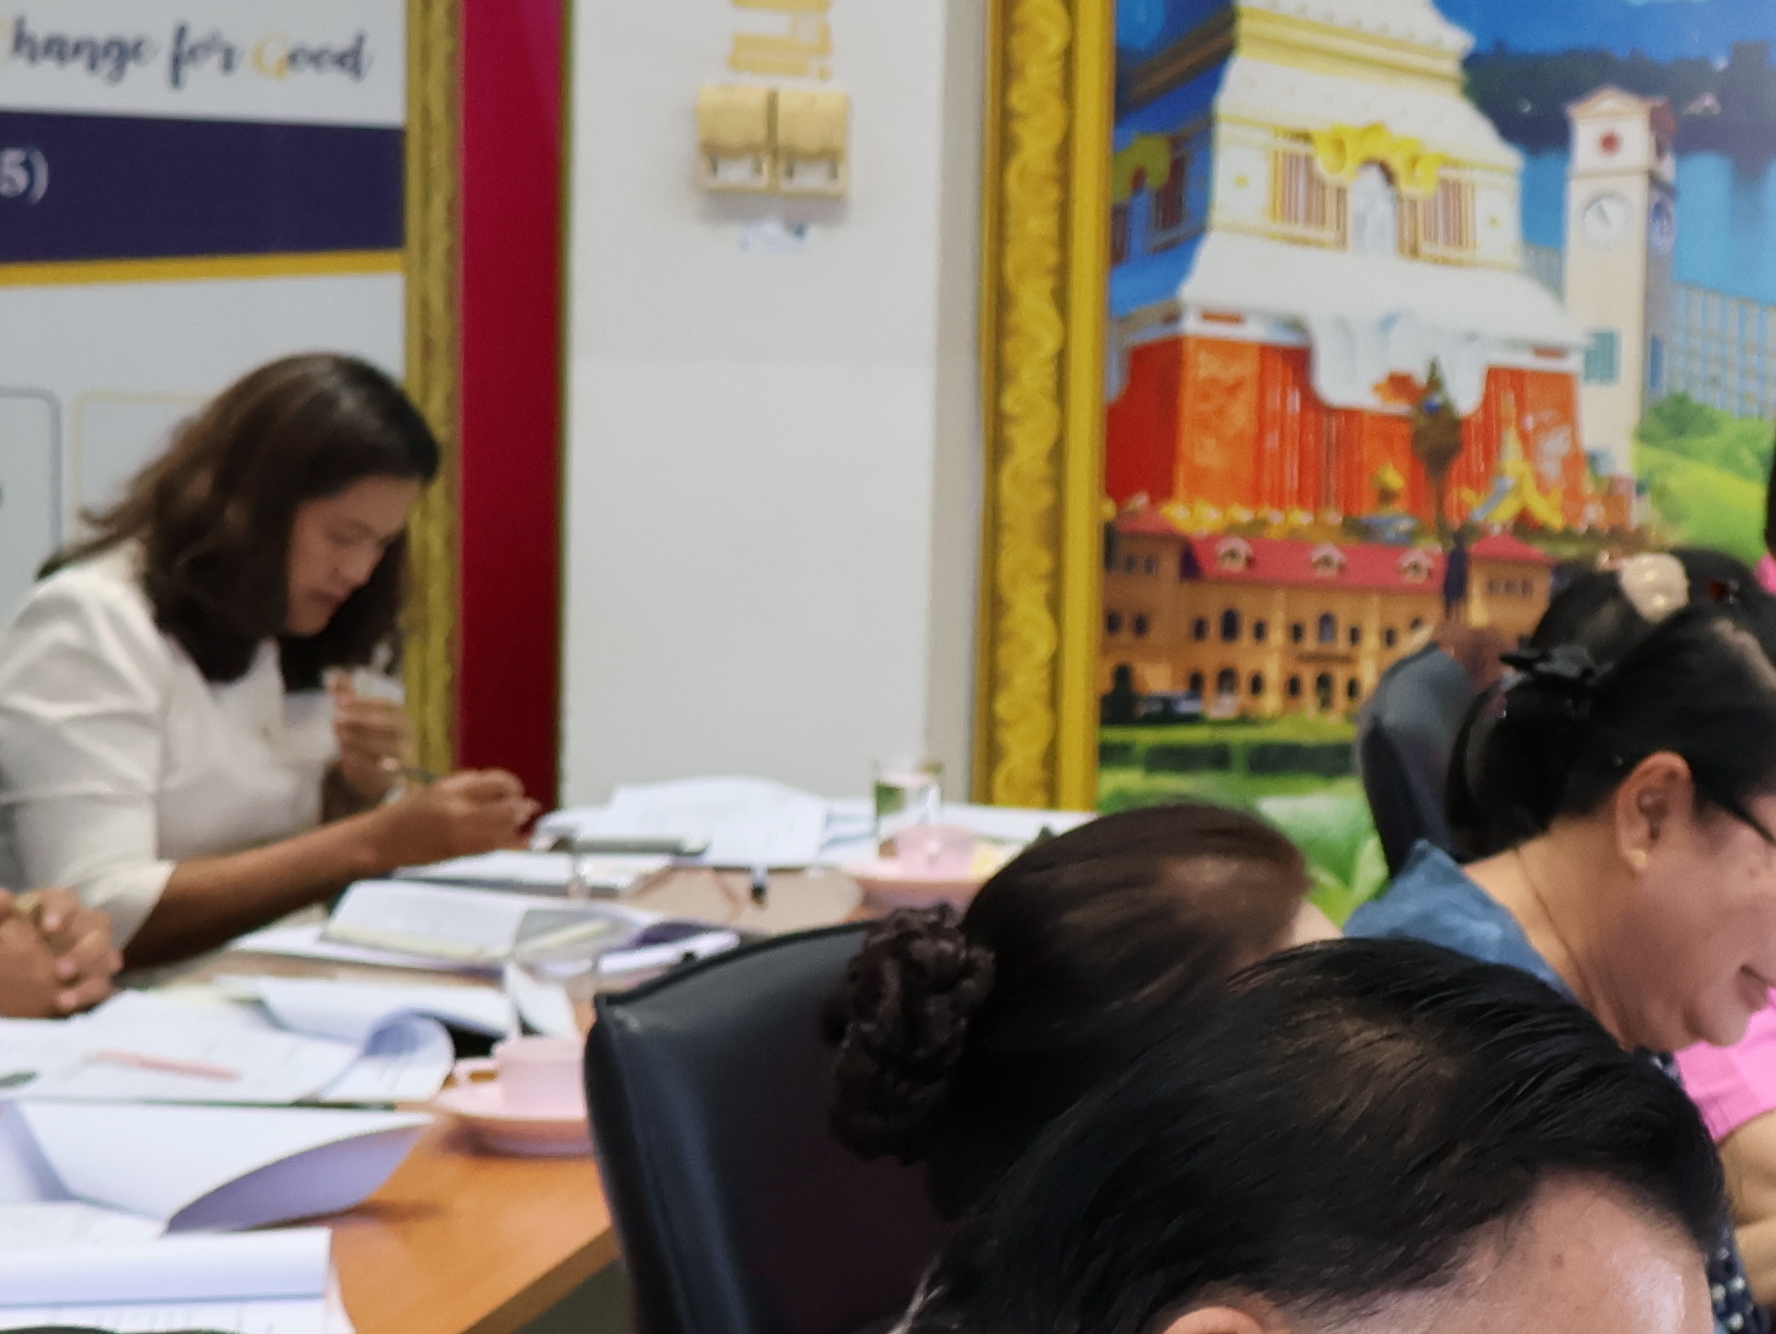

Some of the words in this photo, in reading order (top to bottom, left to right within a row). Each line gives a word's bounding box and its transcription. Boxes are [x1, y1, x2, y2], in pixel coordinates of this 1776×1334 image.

[4, 15, 154, 86] hange
[168, 21, 238, 90] for
[253, 31, 368, 81] Good
